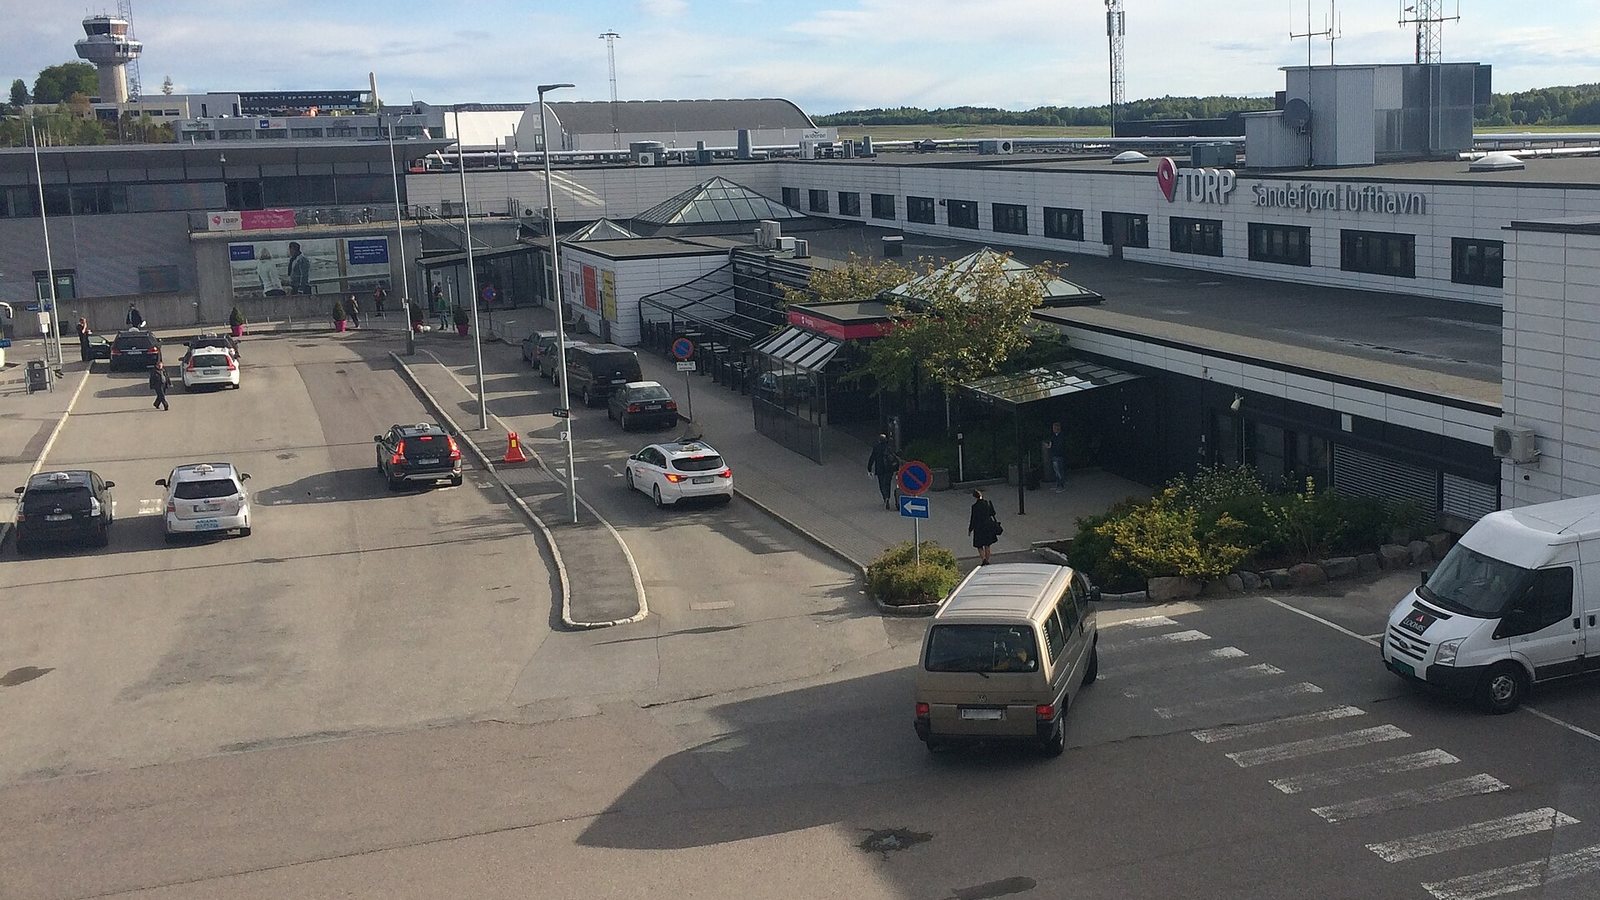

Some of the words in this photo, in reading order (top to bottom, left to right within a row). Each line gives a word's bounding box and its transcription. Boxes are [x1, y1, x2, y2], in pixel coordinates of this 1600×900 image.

[1178, 168, 1236, 205] TORP
[1250, 183, 1338, 213] Sandefjord
[1345, 183, 1426, 215] lufthavn
[1403, 617, 1426, 631] LOOMIS
